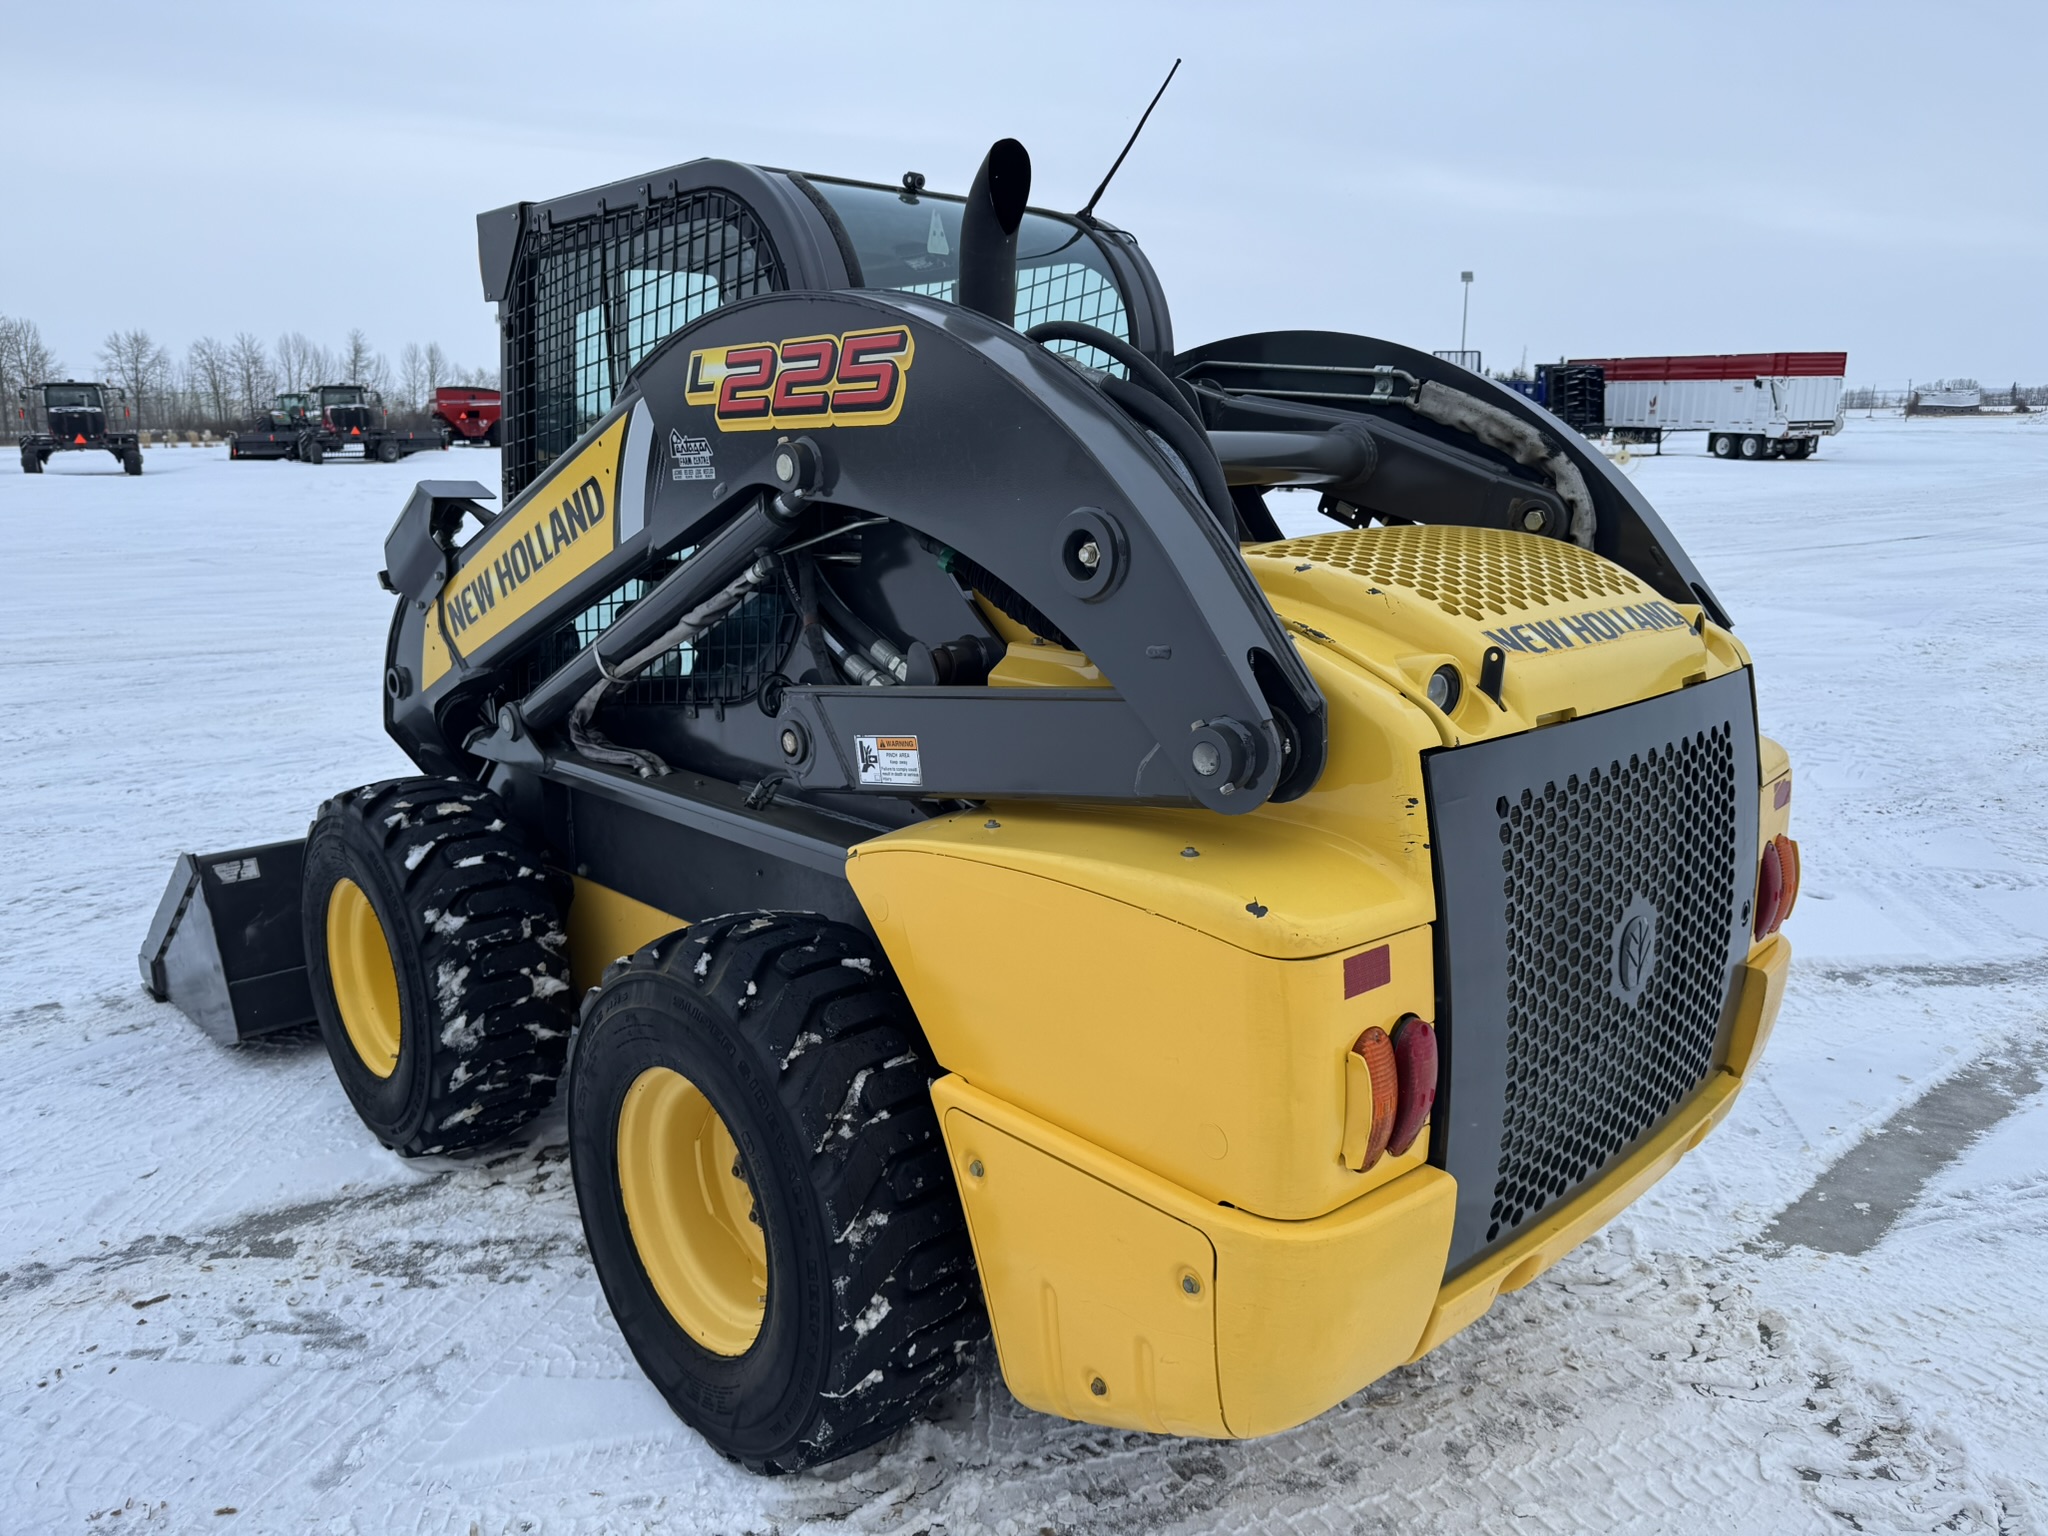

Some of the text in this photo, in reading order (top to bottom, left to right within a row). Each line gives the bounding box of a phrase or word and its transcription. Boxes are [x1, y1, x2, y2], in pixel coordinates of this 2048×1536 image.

[687, 327, 913, 429] L225
[447, 475, 606, 638] NEW HOLLAND
[1482, 600, 1685, 654] NEW HOLLAND
[886, 740, 914, 748] WARNING
[672, 994, 737, 1058] SUPER
